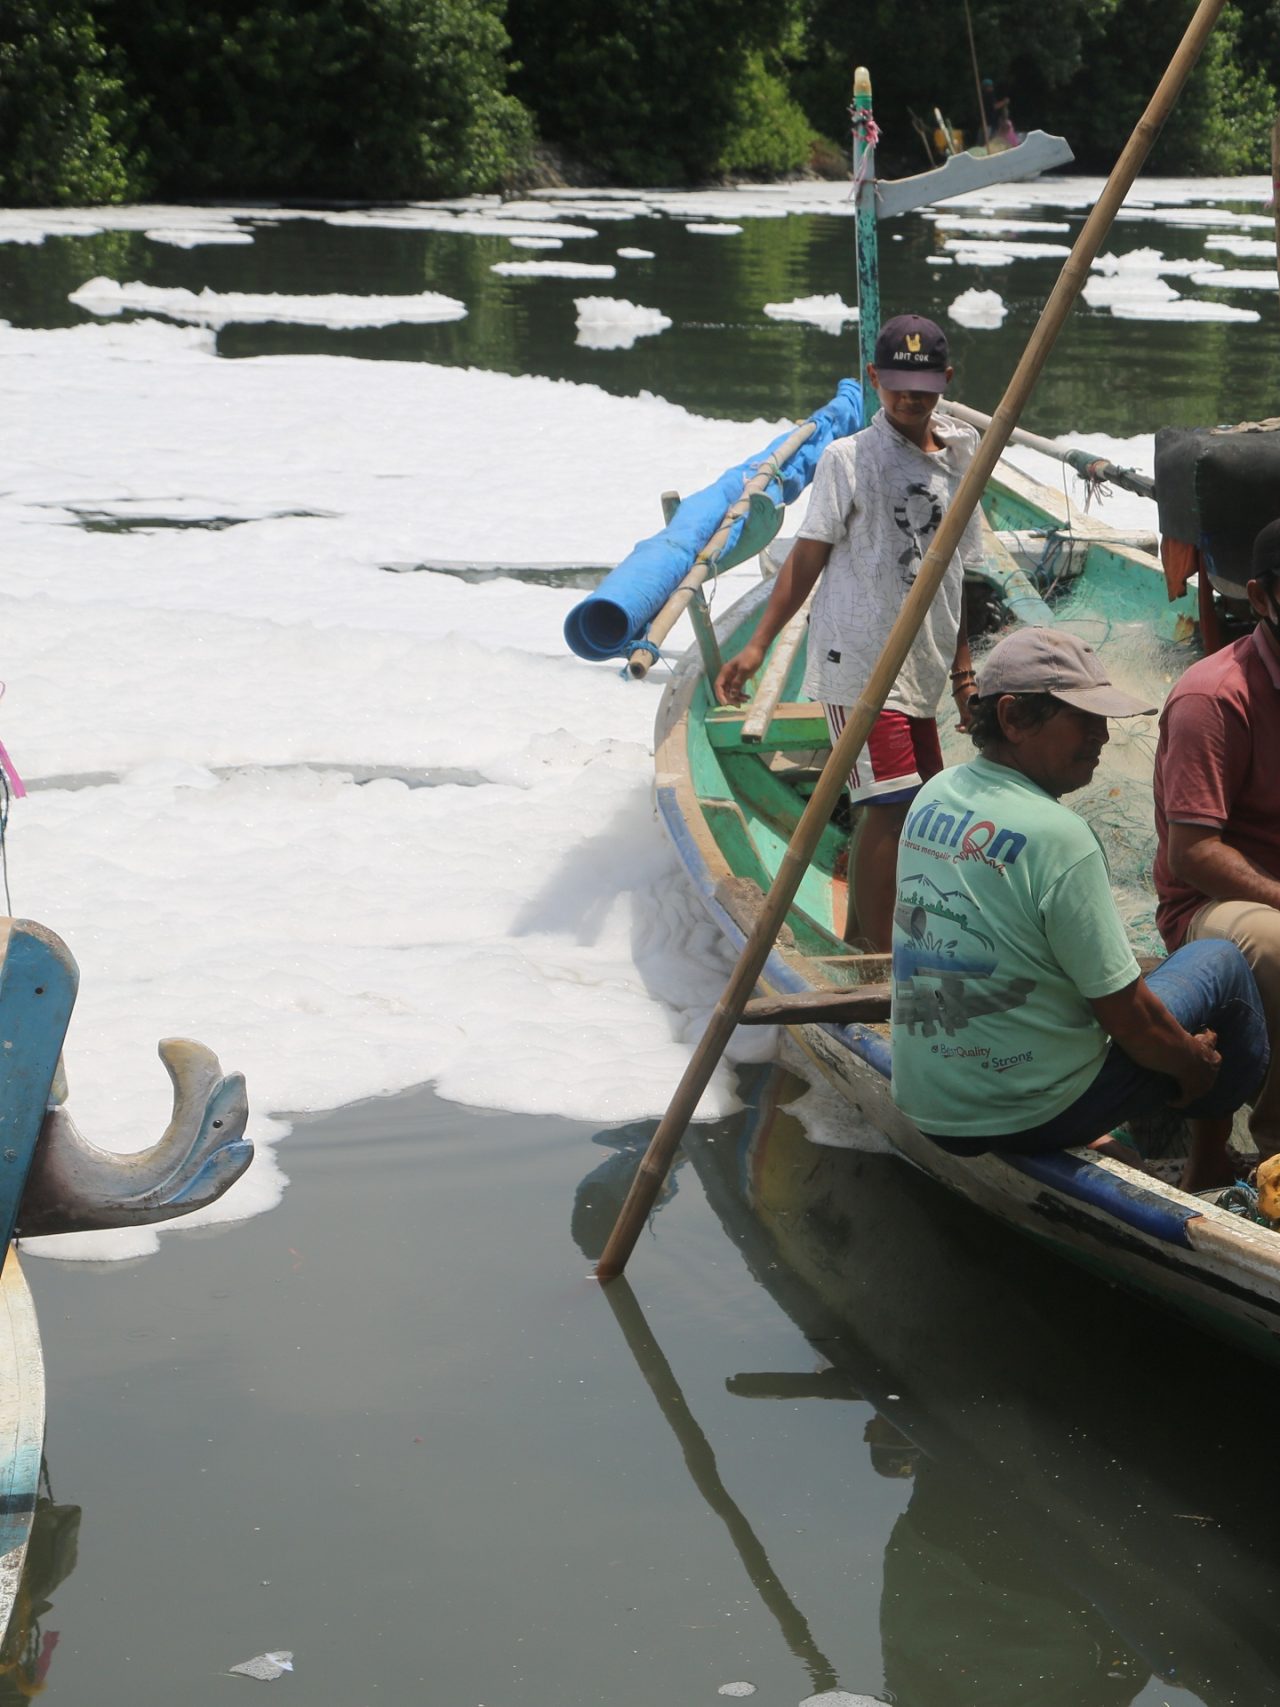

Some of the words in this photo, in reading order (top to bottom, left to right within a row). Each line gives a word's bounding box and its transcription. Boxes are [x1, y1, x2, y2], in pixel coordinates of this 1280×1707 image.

[893, 351, 912, 361] ADIT
[904, 839, 921, 851] terus
[921, 846, 951, 861] mengalir
[991, 1050, 1034, 1069] Strong
